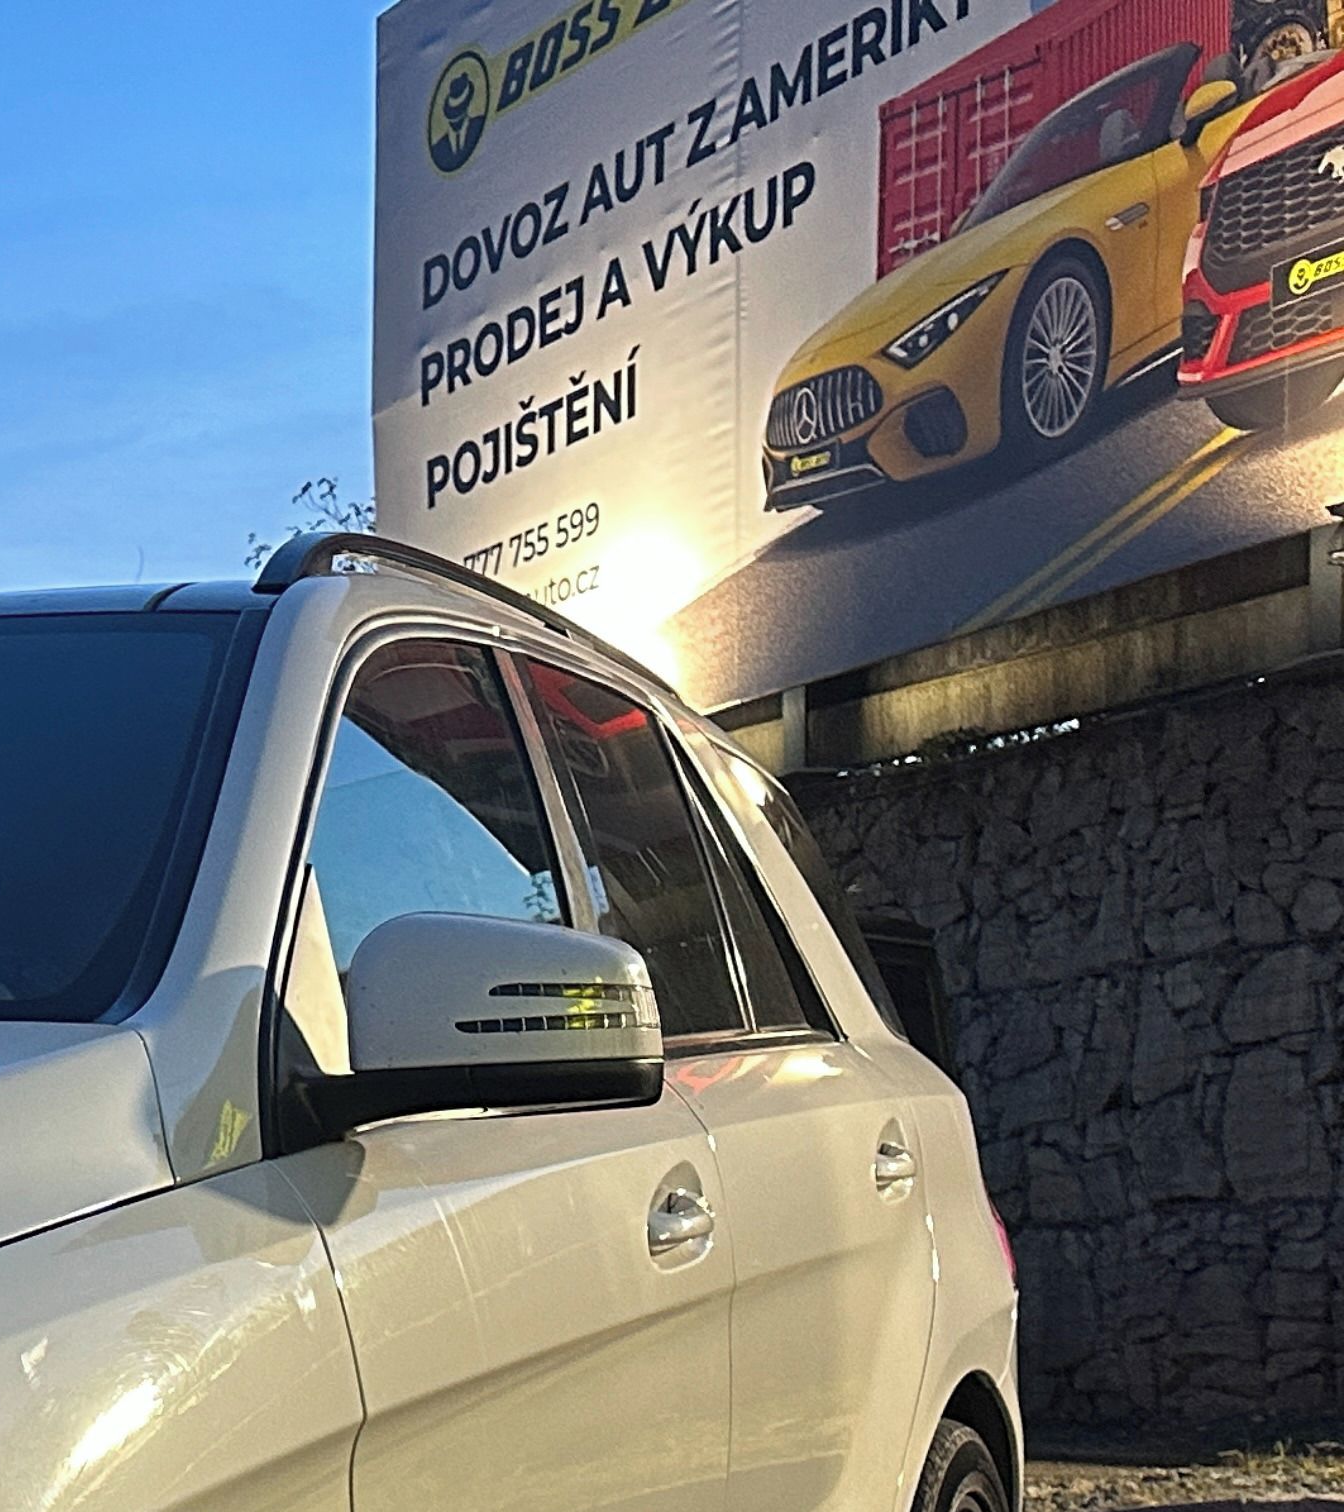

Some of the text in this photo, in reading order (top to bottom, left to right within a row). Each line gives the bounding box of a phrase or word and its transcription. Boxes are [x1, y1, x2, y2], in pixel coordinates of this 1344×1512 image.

[420, 160, 817, 408] PRODEJ A VÝKUP
[422, 180, 570, 311] DOVOZ
[579, 121, 676, 227] AUT
[685, 98, 717, 169] Z
[426, 343, 642, 510] POJIŠTĚNÍ
[509, 521, 550, 568] 755
[555, 502, 600, 548] 599
